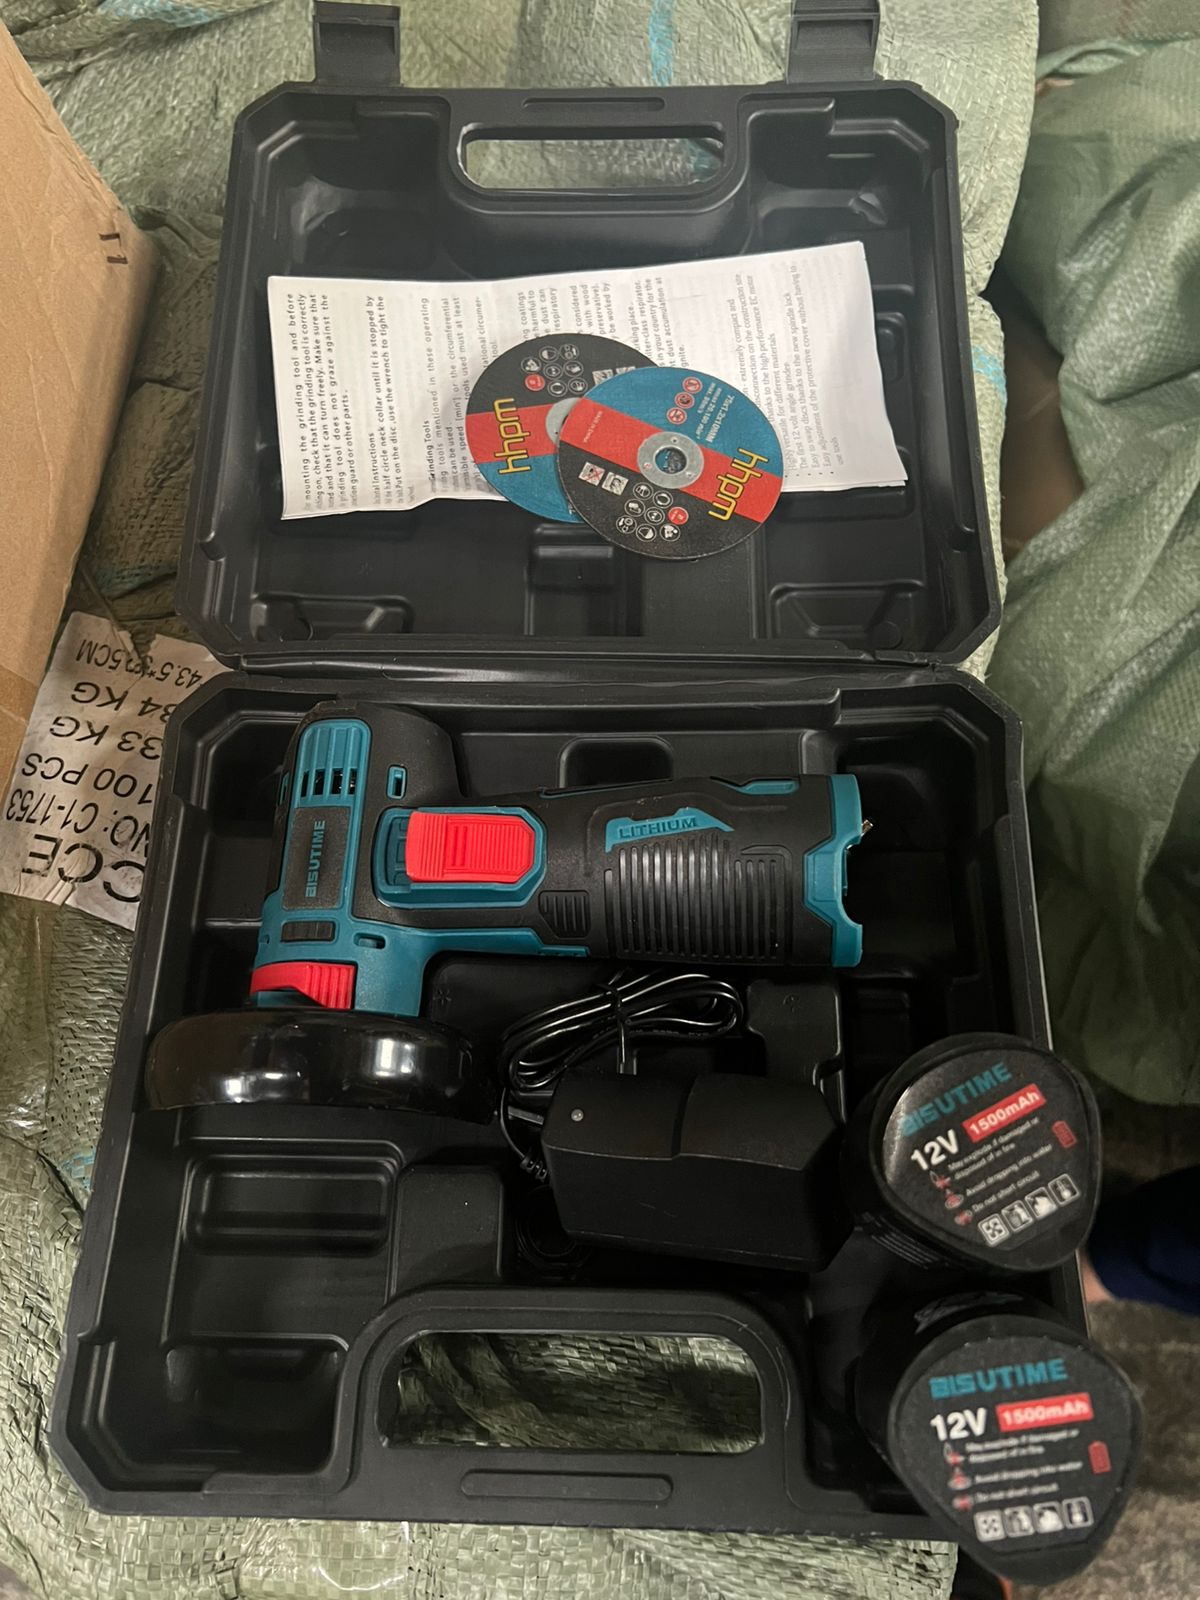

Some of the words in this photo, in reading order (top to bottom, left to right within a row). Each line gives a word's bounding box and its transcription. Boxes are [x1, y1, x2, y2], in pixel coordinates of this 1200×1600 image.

[538, 289, 546, 302] can
[644, 279, 652, 290] the
[287, 294, 296, 326] before
[310, 294, 318, 312] that
[376, 296, 384, 310] the
[452, 297, 460, 317] least
[517, 292, 528, 325] coatings
[569, 285, 582, 326] considered
[602, 294, 614, 321] worked
[646, 293, 654, 303] for
[298, 294, 307, 334] correctly
[312, 316, 320, 335] sure
[378, 314, 389, 336] tight
[420, 298, 432, 342] operating
[540, 307, 549, 324] dust
[648, 304, 660, 332] country
[322, 316, 334, 352] against
[366, 310, 378, 347] stopped
[441, 298, 456, 360] circumferential
[290, 333, 298, 350] and
[313, 339, 322, 363] Make
[456, 332, 465, 352] must
[654, 334, 664, 351] your
[666, 340, 675, 357] dust
[292, 357, 300, 377] tool
[302, 346, 310, 364] tool
[426, 348, 434, 371] these
[460, 357, 468, 376] used
[327, 359, 338, 386] graze
[382, 352, 392, 384] wrench
[449, 365, 457, 378] the
[305, 368, 316, 407] grinding
[372, 372, 381, 393] until
[294, 385, 307, 428] grinding
[385, 388, 393, 402] the
[308, 410, 316, 425] the
[320, 400, 328, 420] turn
[375, 397, 384, 422] collar
[430, 390, 442, 438] mentioned
[310, 429, 318, 447] that
[321, 424, 329, 440] can
[332, 416, 340, 440] does
[342, 422, 353, 446] other
[378, 426, 386, 446] neck
[389, 426, 398, 443] disc
[422, 420, 432, 442] Tools
[446, 427, 454, 446] used
[457, 426, 466, 450] speed
[493, 397, 532, 475] hhpm
[299, 436, 307, 452] the
[334, 447, 343, 465] tool
[391, 447, 399, 460] the
[436, 444, 445, 464] tools
[312, 450, 321, 474] check
[323, 454, 332, 472] that
[368, 432, 380, 483] Instructions
[381, 450, 390, 472] circle
[450, 460, 458, 474] can
[325, 476, 334, 490] and
[347, 460, 357, 484] guard
[708, 448, 769, 521] hhpm
[71, 681, 129, 711] KG
[50, 716, 110, 746] KG
[117, 731, 163, 760] 33
[21, 752, 89, 786] PCS
[93, 768, 153, 805] 100
[6, 788, 99, 834] C1-1753
[618, 816, 699, 840] LITHIUM
[305, 820, 326, 898] BISUTIME
[902, 1062, 1013, 1136] BISUTIME
[911, 1129, 959, 1171] 12V
[969, 1090, 1040, 1135] 1500mAh
[929, 1358, 1068, 1399] BISUTIME
[930, 1407, 987, 1441] 12V
[1003, 1400, 1089, 1425] 1500mAh
